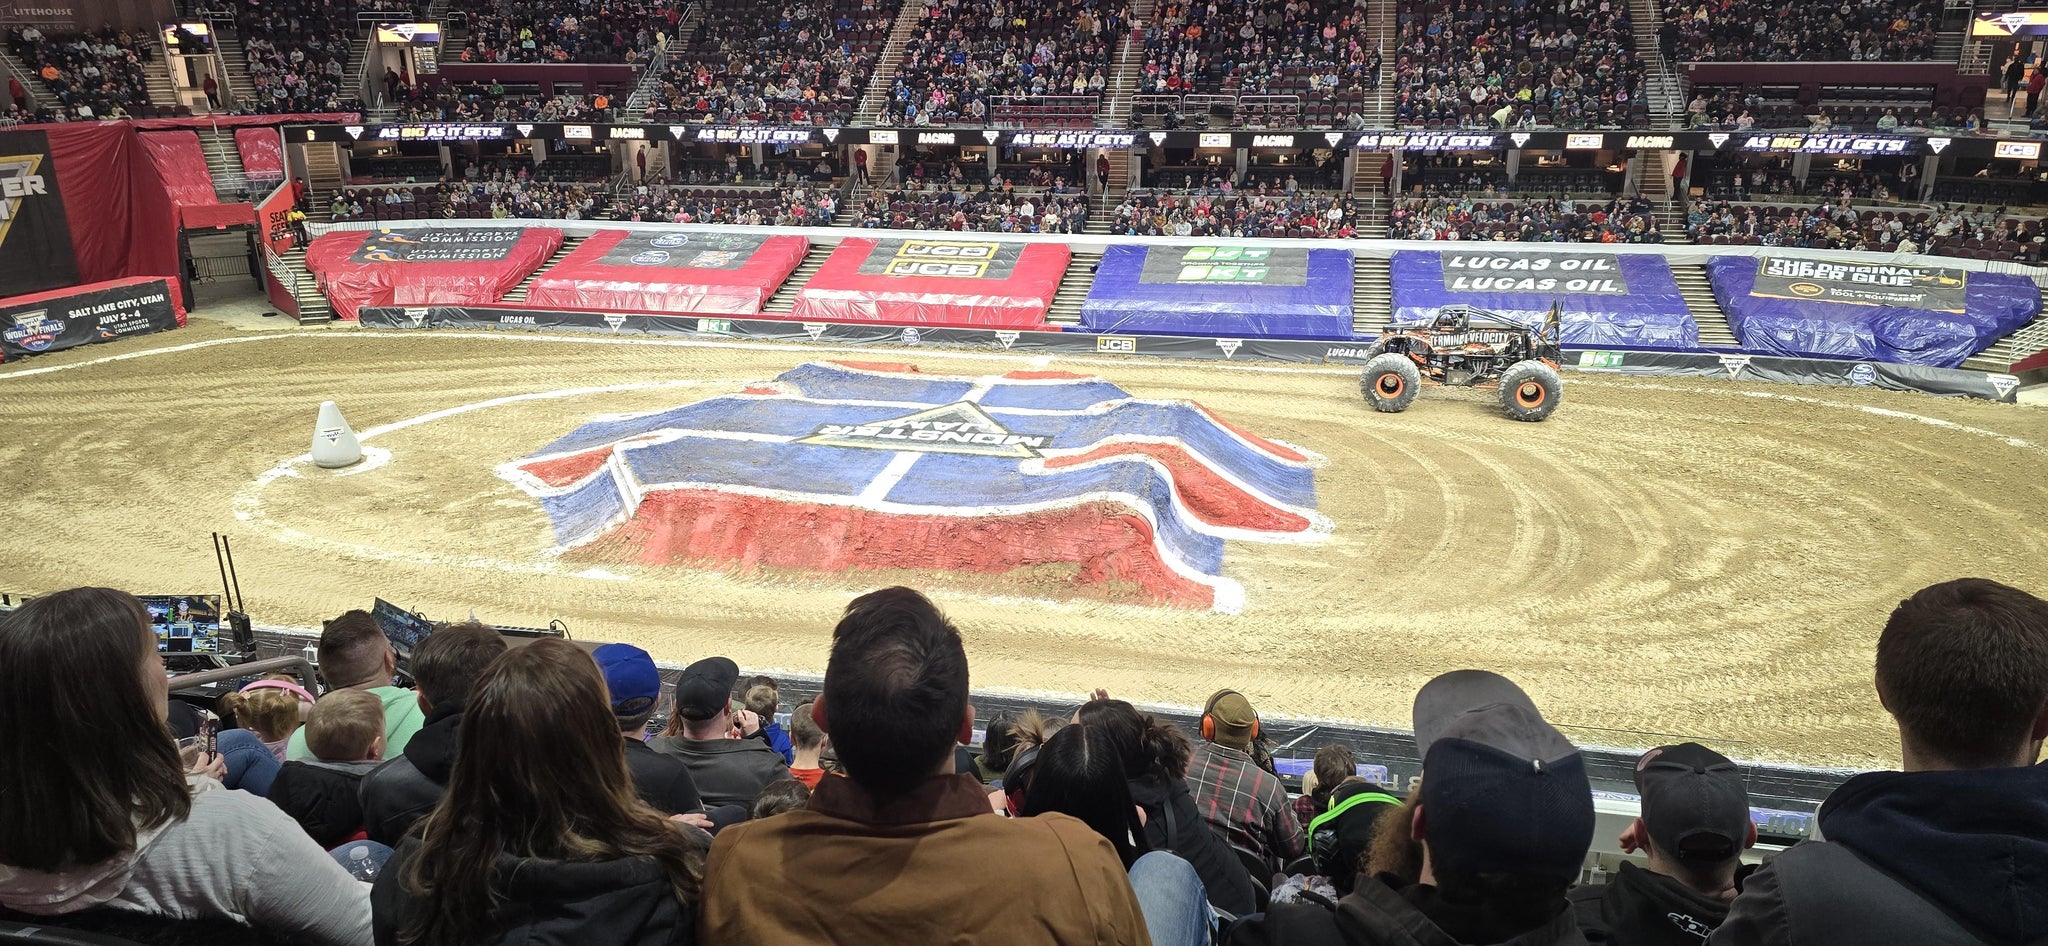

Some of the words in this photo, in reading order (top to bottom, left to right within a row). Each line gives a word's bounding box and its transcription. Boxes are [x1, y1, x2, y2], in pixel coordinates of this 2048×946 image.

[13, 8, 73, 16] LITEHOUSE
[379, 128, 399, 138] AS
[401, 128, 425, 138] BIG
[427, 127, 447, 137] AS
[447, 127, 462, 137] IT
[610, 127, 645, 139] RACING
[697, 130, 715, 140] AS
[716, 130, 738, 140] BIG
[739, 130, 758, 140] AS
[758, 130, 773, 140] IT
[917, 132, 955, 144] RACING
[1012, 133, 1032, 144] AS
[1033, 133, 1056, 144] BIG
[1057, 133, 1077, 144] AS
[1077, 133, 1094, 144] IT
[1252, 135, 1294, 147] RACING
[1356, 135, 1379, 146] AS
[1379, 135, 1407, 147] BIG
[1407, 135, 1430, 146] AS
[1430, 135, 1447, 146] IT
[1626, 136, 1674, 148] RACING
[1744, 137, 1771, 148] AS
[1771, 137, 1802, 148] BIG
[1802, 138, 1829, 149] AS
[1829, 138, 1850, 149] IT
[1851, 139, 1906, 151] GETS!
[2000, 145, 2038, 156] JCB
[270, 209, 288, 224] SEAT
[906, 244, 989, 256] JCB
[894, 261, 979, 276] JCB
[1449, 256, 1552, 271] LUCAS
[1770, 258, 1814, 271] THE
[1815, 263, 1927, 278] ORIGINAL
[1766, 266, 1846, 281] SUPER
[1851, 272, 1914, 287] GLUE
[1451, 276, 1558, 290] LUCAS
[1831, 291, 1856, 299] TOOL
[68, 308, 92, 320] SALT
[92, 302, 117, 315] LAKE
[141, 293, 165, 306] UTAH
[99, 313, 120, 326] JULY
[500, 315, 524, 324] LUCAS
[524, 316, 536, 325] OIL
[39, 322, 64, 334] FINALS
[114, 323, 150, 335] COMMISSION
[1469, 331, 1510, 345] VELOCITY
[1099, 339, 1133, 350] JCB
[1326, 347, 1357, 358] LUCAS
[888, 421, 993, 433] JAM
[820, 424, 1045, 447] MONSTER
